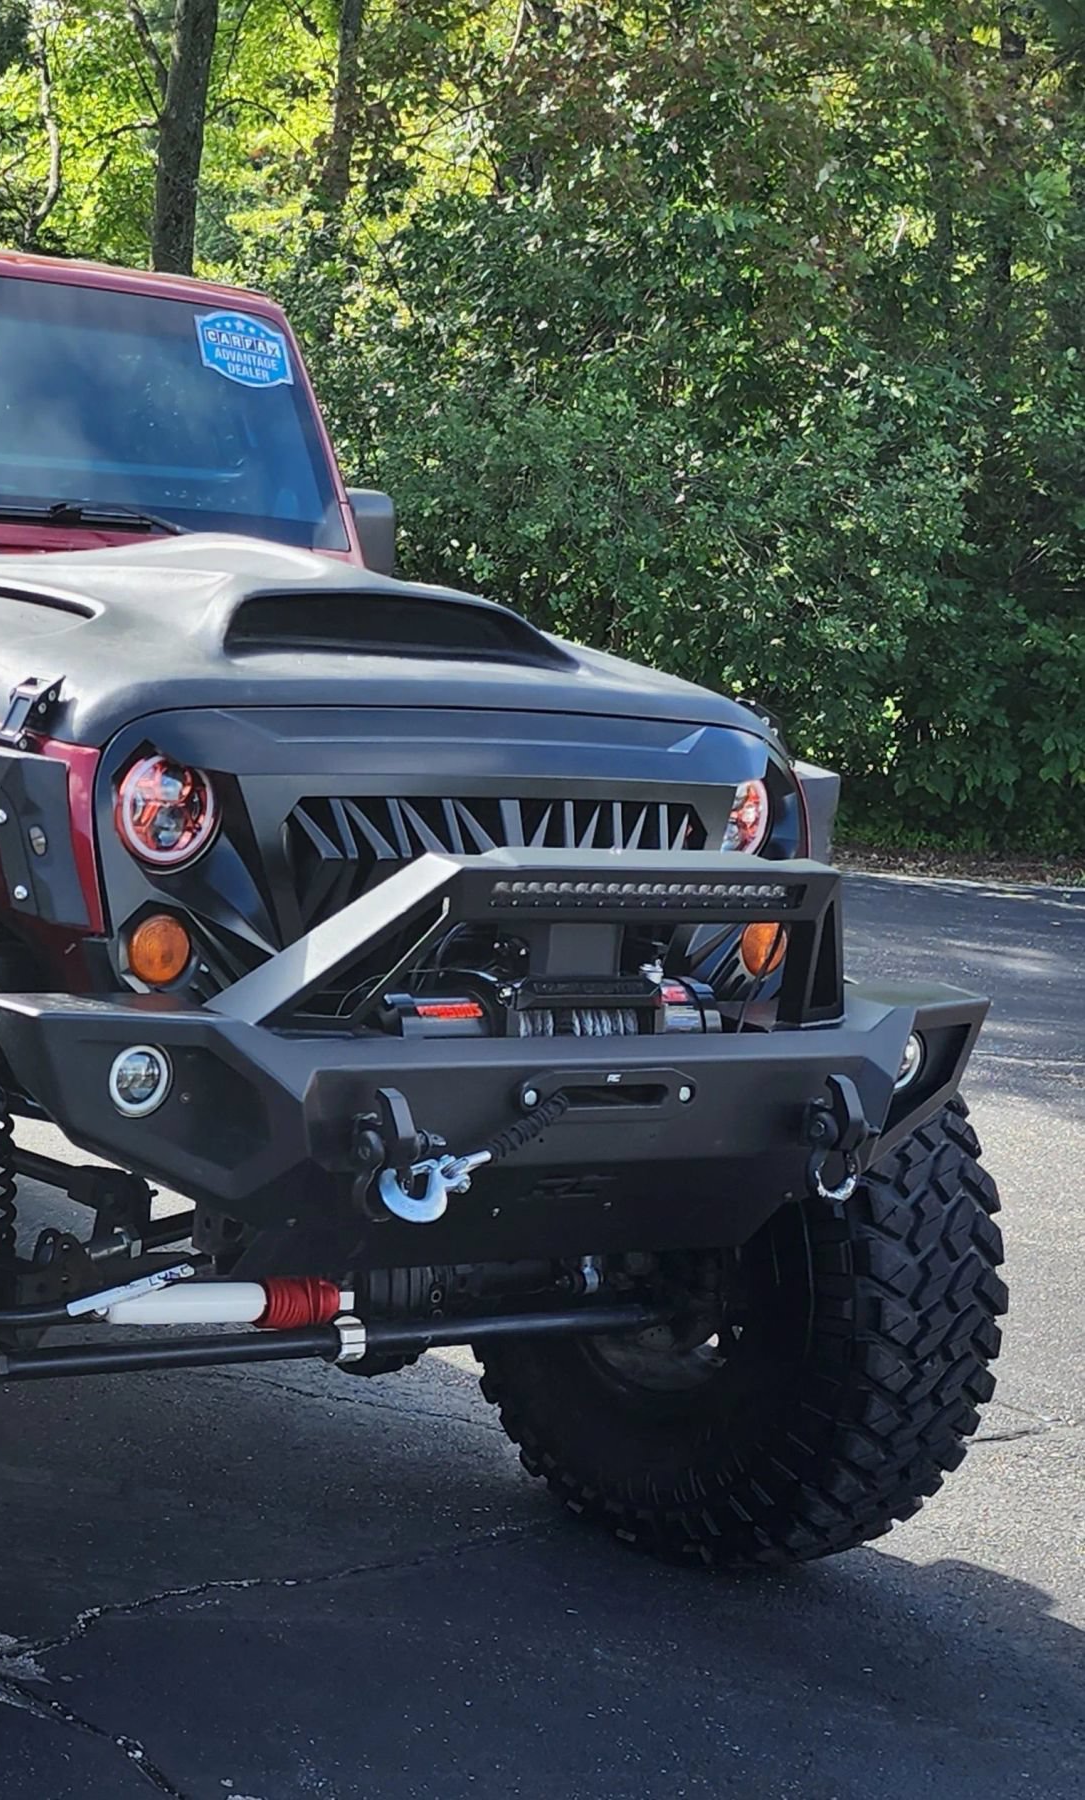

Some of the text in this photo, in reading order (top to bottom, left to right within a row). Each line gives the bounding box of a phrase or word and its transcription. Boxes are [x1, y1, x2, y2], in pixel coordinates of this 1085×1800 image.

[207, 330, 281, 357] CARFAX
[215, 347, 279, 371] ADVANTAGE
[227, 362, 270, 382] DEALER
